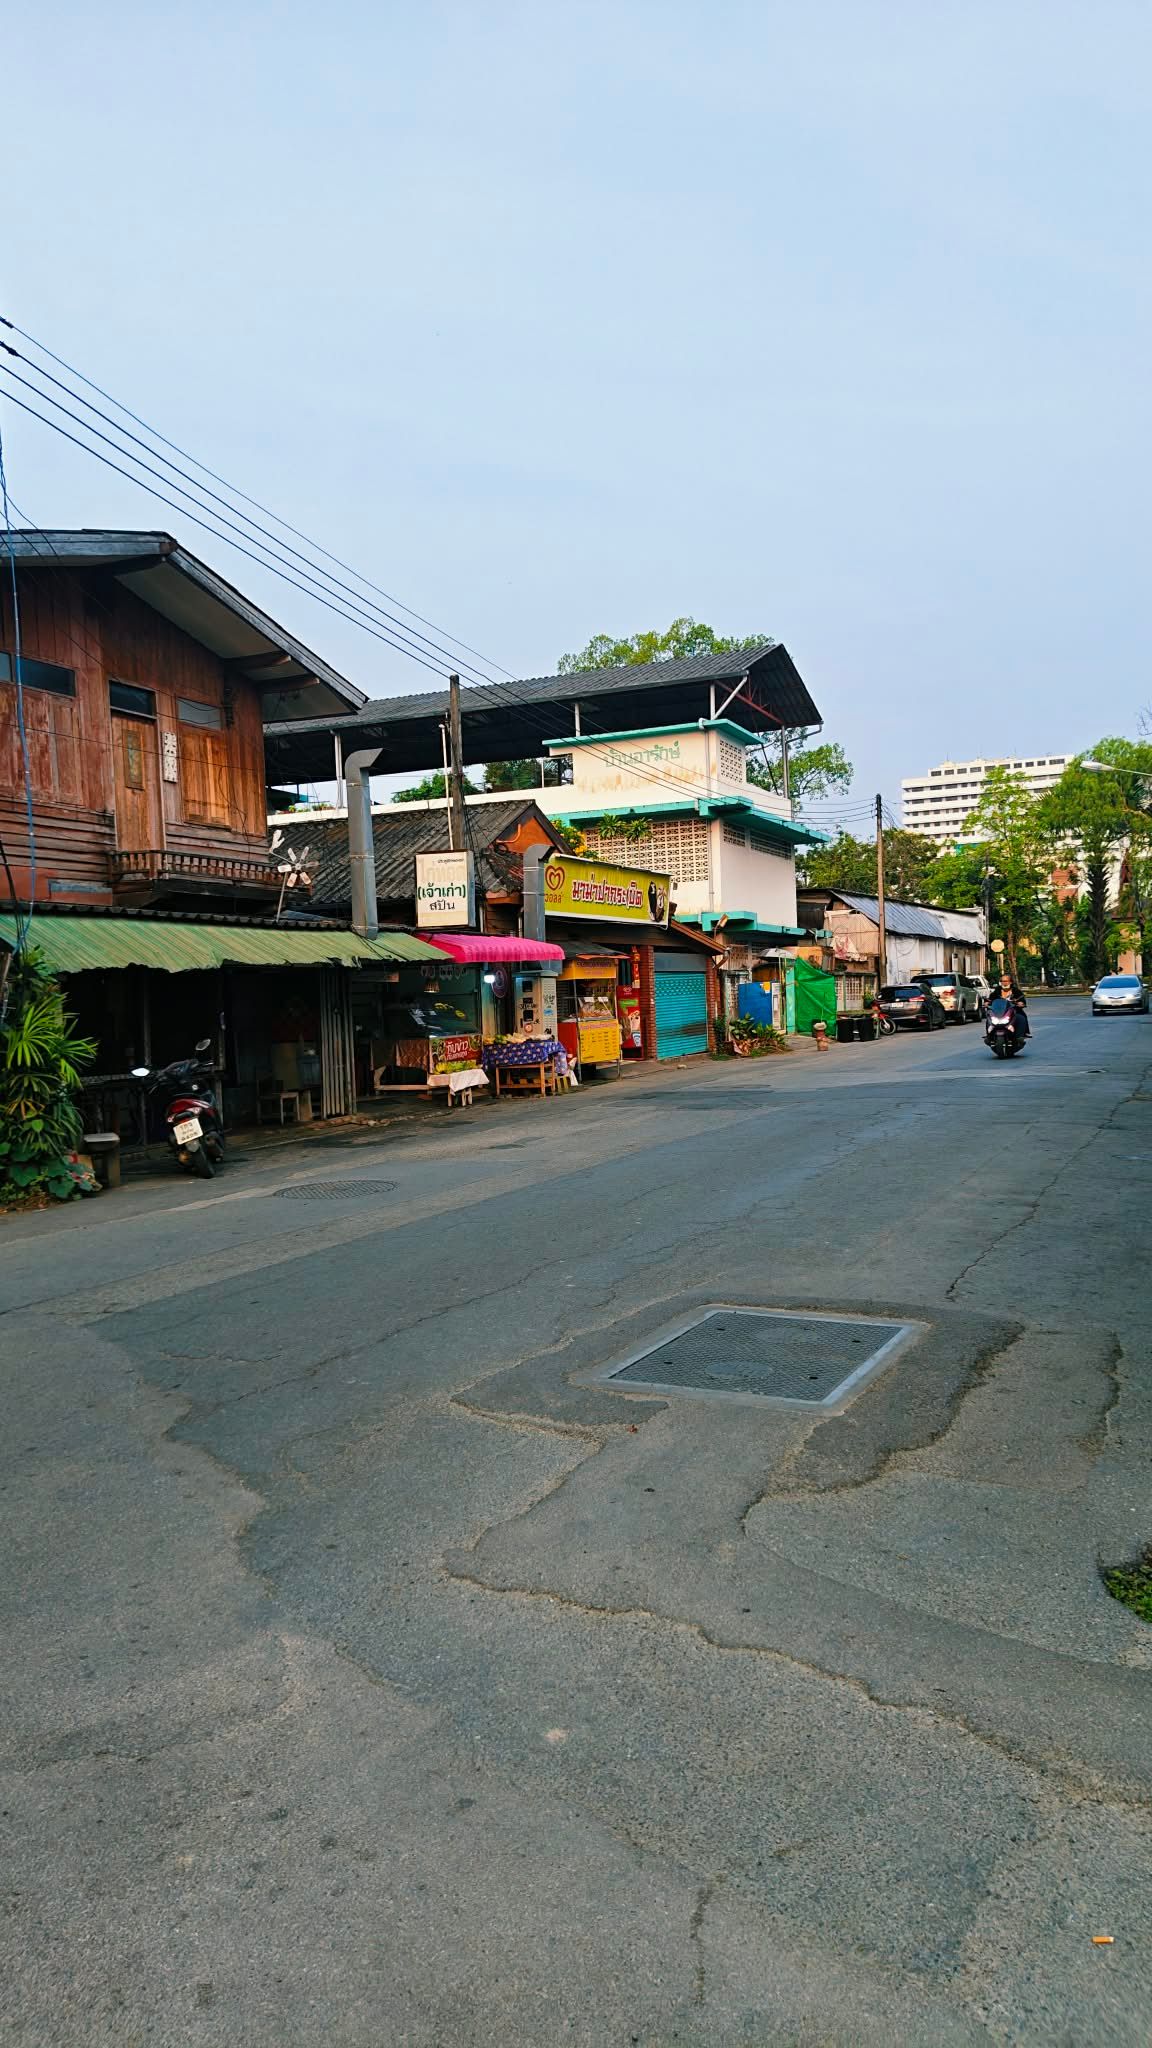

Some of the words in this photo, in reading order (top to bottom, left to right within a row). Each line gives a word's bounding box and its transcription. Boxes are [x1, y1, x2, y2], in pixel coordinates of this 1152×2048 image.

[603, 741, 681, 767] บ้านอารักษ์
[417, 882, 466, 900] (เจ้าเก่า)
